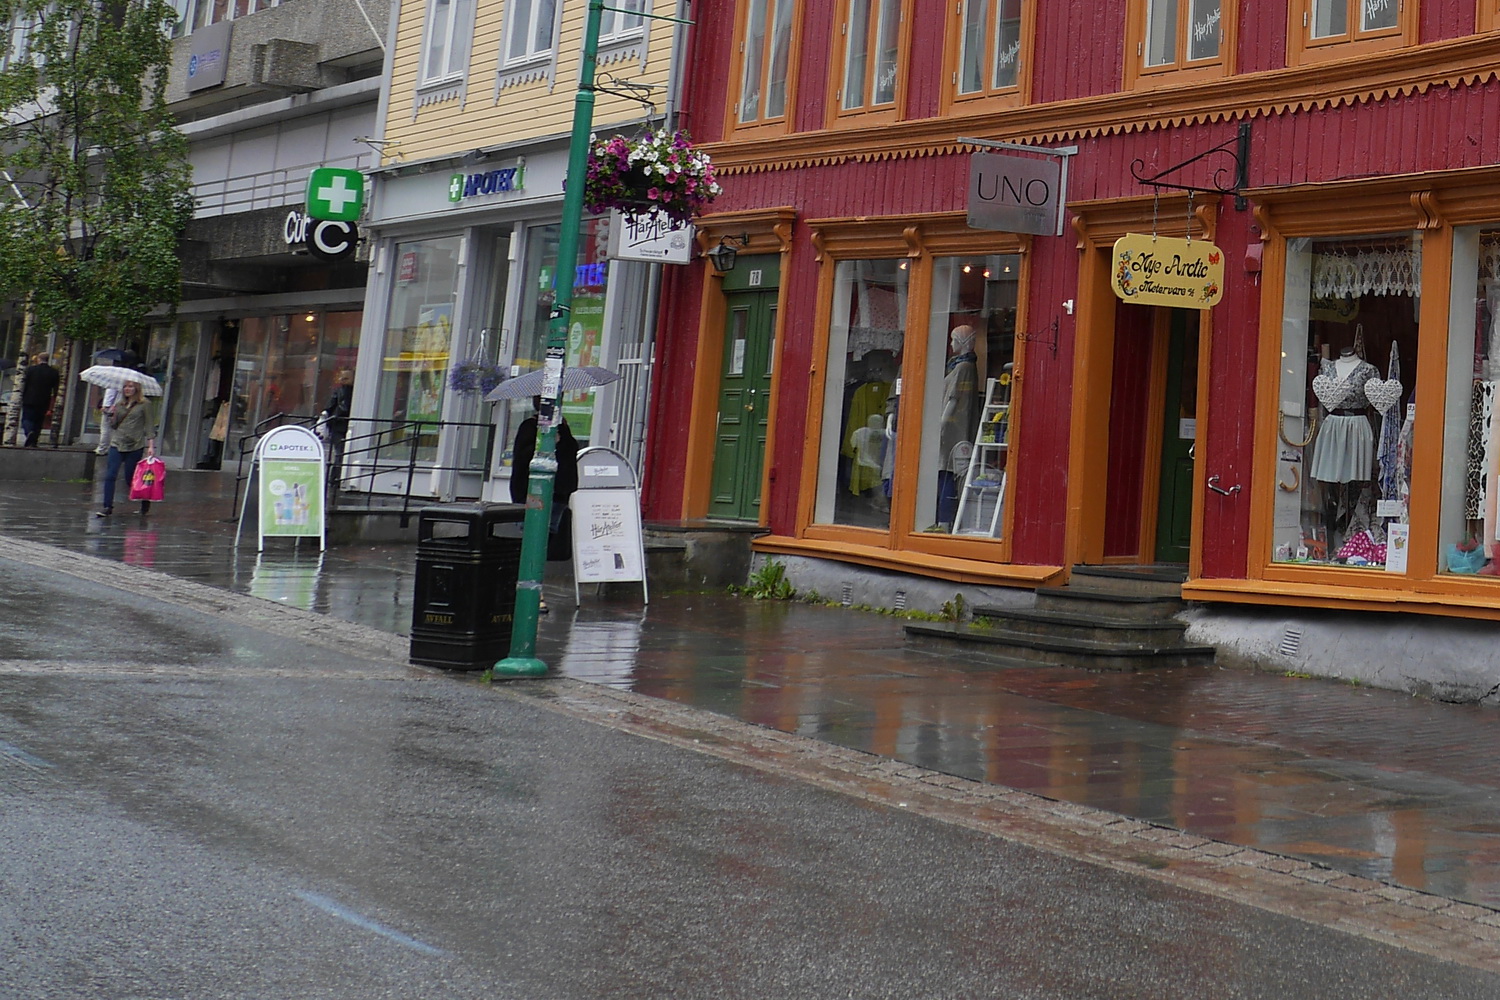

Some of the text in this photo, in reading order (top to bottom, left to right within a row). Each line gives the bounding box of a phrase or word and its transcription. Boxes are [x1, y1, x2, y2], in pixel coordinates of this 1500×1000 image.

[463, 167, 517, 197] APOTEK
[977, 172, 1049, 206] UNO
[751, 271, 761, 285] 78
[1131, 252, 1209, 279] Nye Arctic
